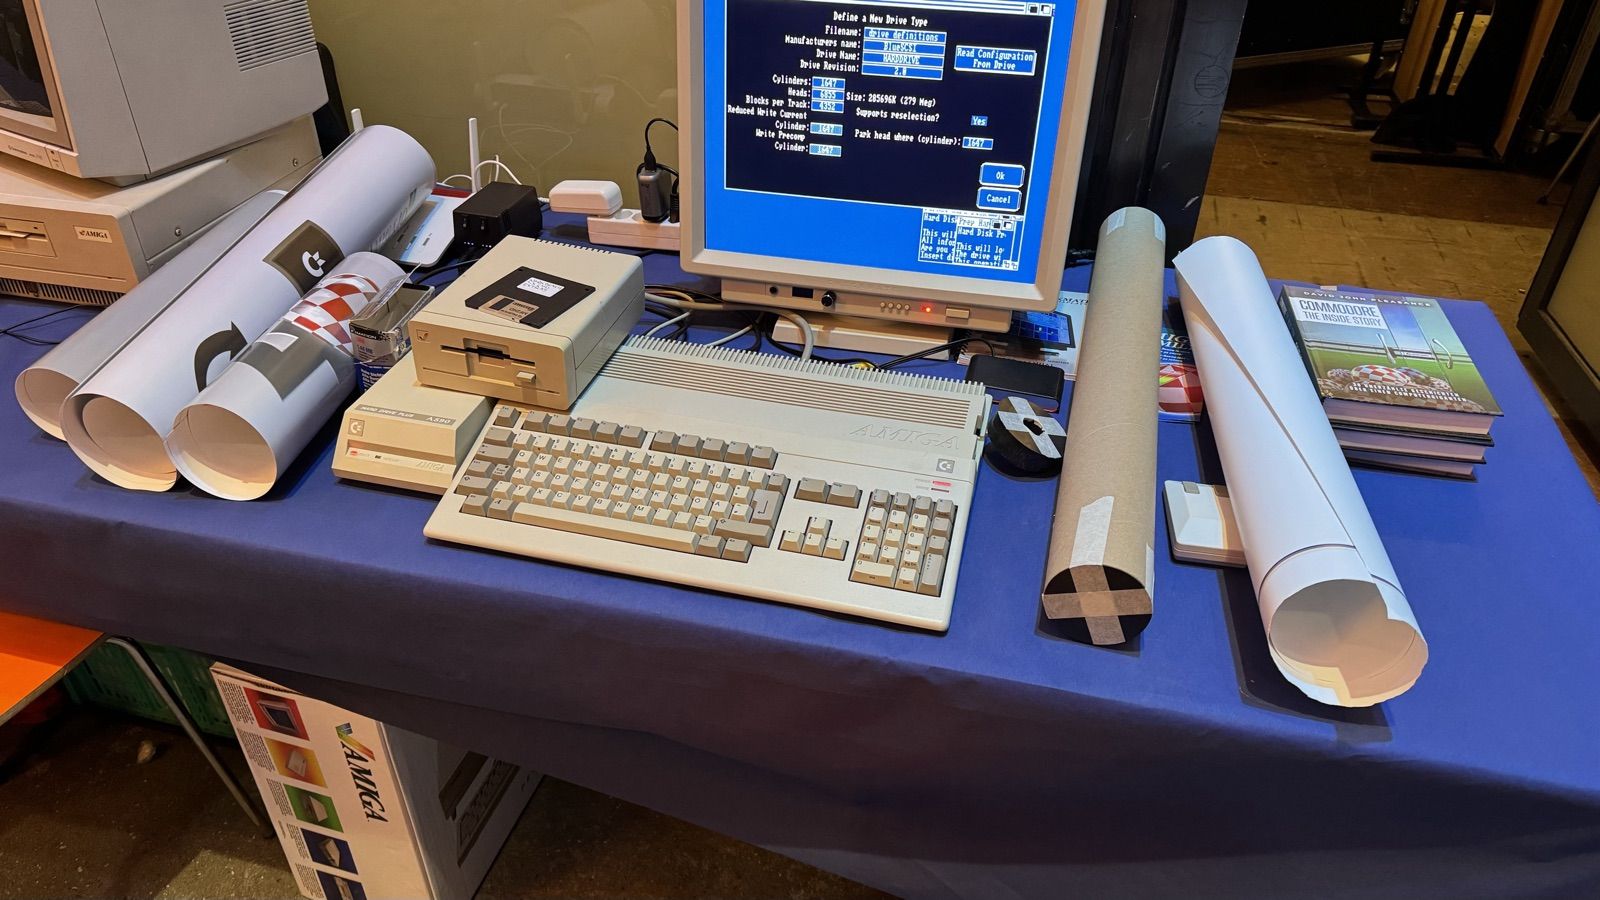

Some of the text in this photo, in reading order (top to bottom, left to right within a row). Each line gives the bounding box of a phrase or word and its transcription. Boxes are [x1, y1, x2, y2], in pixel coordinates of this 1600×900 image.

[833, 11, 858, 22] Define
[870, 14, 884, 24] New
[886, 14, 908, 25] Drive
[911, 16, 928, 27] Type
[825, 25, 862, 36] Filename:
[868, 29, 938, 42] drive definitions
[784, 35, 860, 48] Manufacturers name:
[816, 48, 860, 60] Drive Name:
[957, 48, 1034, 62] Read Configuration
[800, 60, 859, 72] Drive Revision:
[972, 58, 1016, 70] From Drive
[772, 74, 811, 86] Cylinders:
[788, 87, 811, 98] Heads:
[746, 94, 810, 108] Blocks per Track:
[846, 92, 866, 102] Size:
[900, 95, 916, 106] (279
[919, 98, 936, 108] Meg)
[728, 104, 808, 120] Reduced Write Current
[856, 108, 940, 122] Supports reselection?
[774, 120, 810, 131] Cylinder:
[972, 116, 986, 126] Yes
[756, 128, 806, 142] Write Precomp
[854, 128, 960, 146] Park head where (cylinder):
[774, 141, 809, 152] Cylinder:
[995, 171, 1006, 180] Ok
[986, 194, 1012, 204] Cancel
[924, 212, 940, 222] Hard
[85, 230, 108, 240] AMIGA
[922, 228, 938, 237] This
[958, 226, 974, 236] Hard
[976, 229, 994, 238] Disk
[921, 236, 933, 244] All
[920, 244, 948, 254] Are you
[956, 242, 972, 250] This
[975, 244, 990, 252] will
[920, 251, 944, 260] Insert
[956, 250, 968, 258] The
[970, 251, 990, 260] drive
[1300, 300, 1379, 318] COMMODORE
[1304, 311, 1381, 326] THE INSIDE STORY
[426, 416, 451, 424] A590
[850, 424, 960, 450] AMIGA
[340, 741, 389, 822] AMIGA
